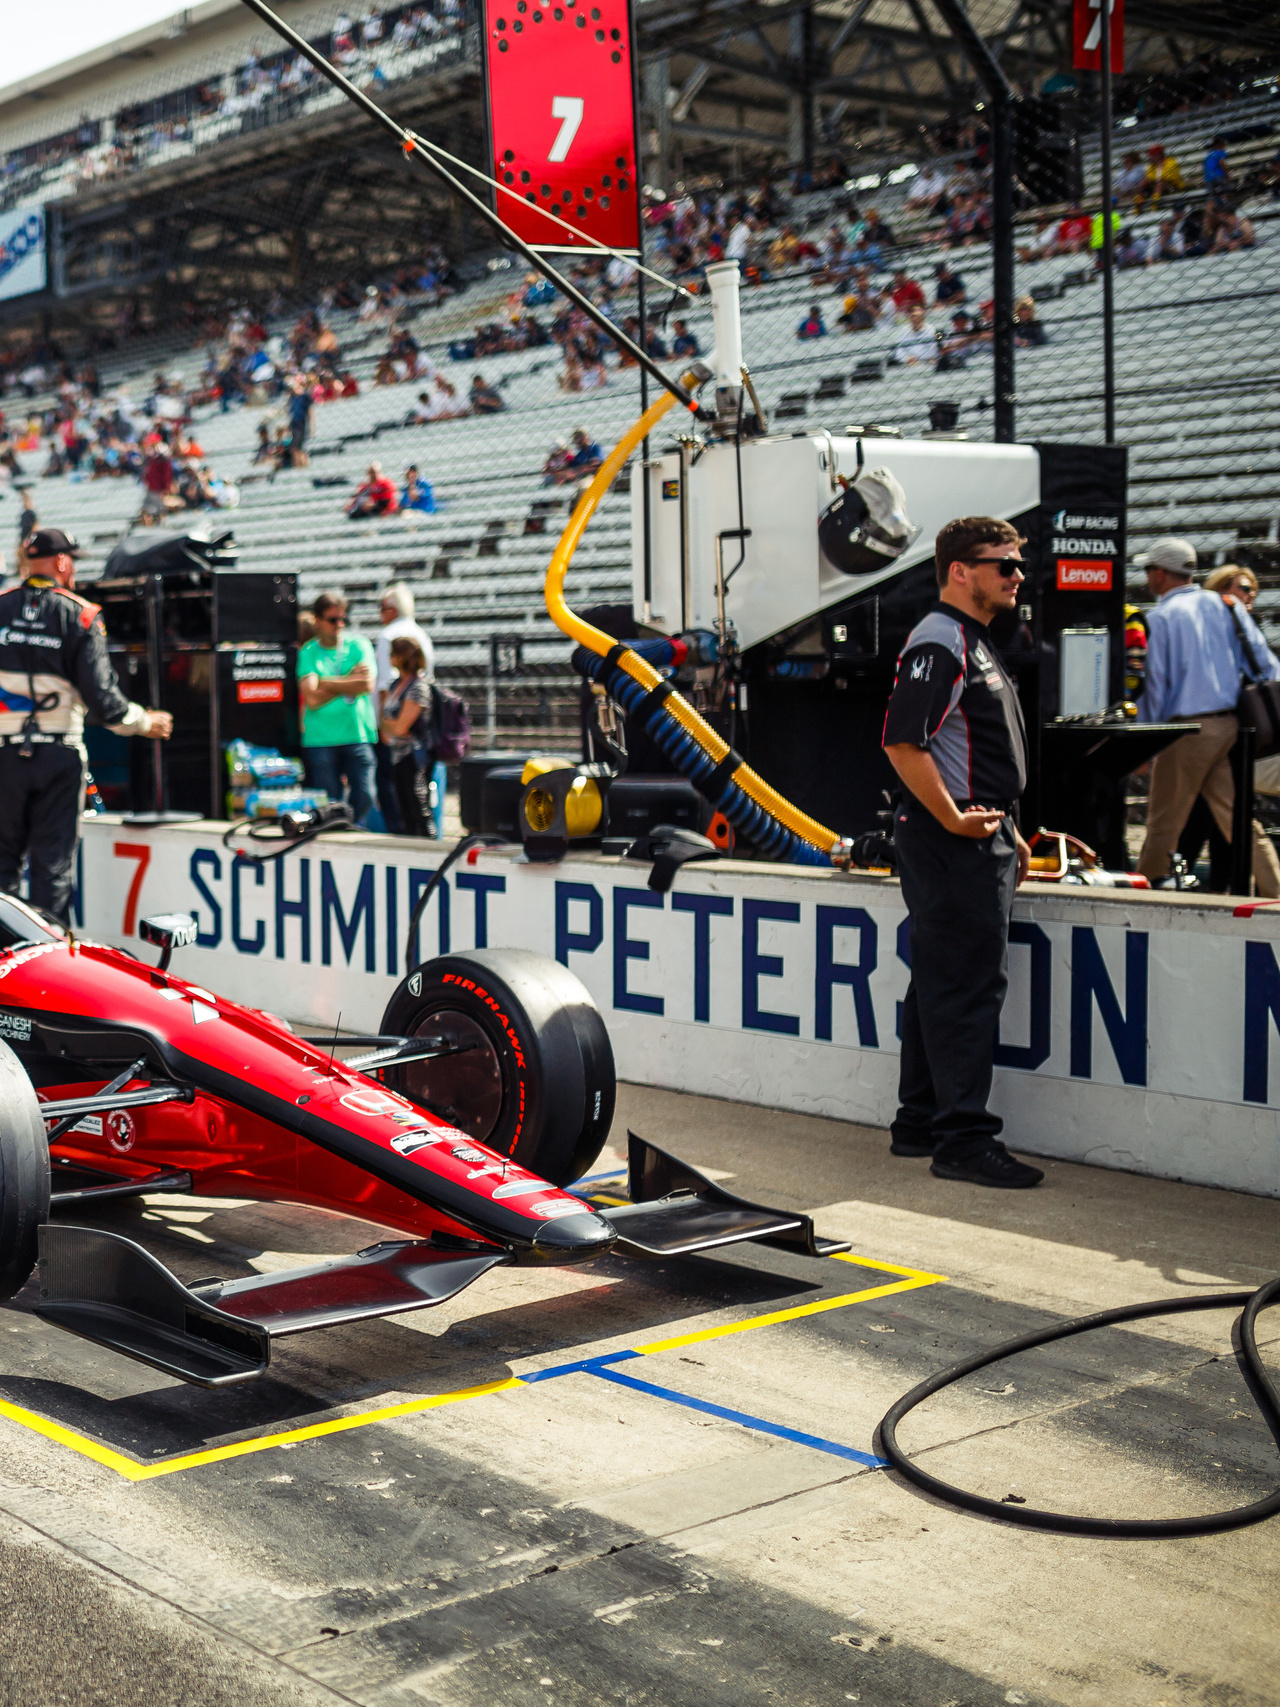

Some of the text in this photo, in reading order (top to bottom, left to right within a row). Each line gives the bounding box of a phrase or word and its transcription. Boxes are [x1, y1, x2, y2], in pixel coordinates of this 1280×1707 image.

[548, 95, 584, 163] 7
[1051, 537, 1119, 556] HONDA
[1061, 565, 1108, 585] Lenovo
[113, 841, 151, 937] 7
[189, 847, 507, 977] SCHMIDT
[554, 878, 1150, 1088] PETERON
[441, 973, 527, 1070] FIREHAWK
